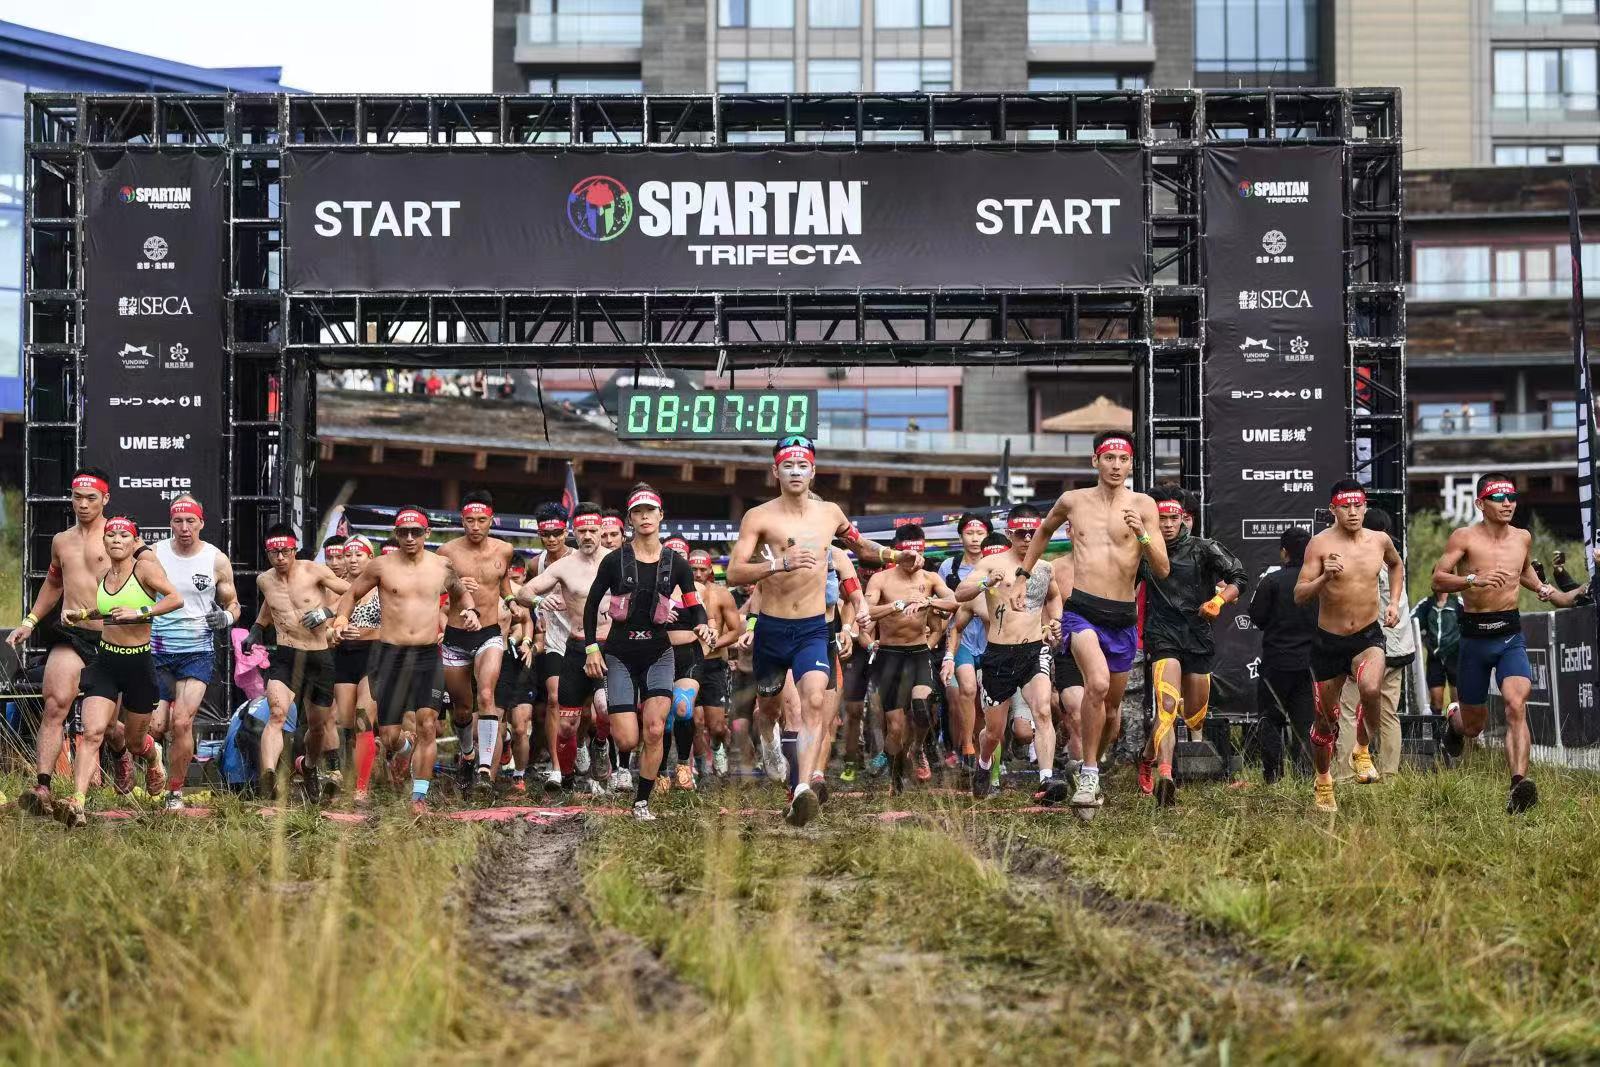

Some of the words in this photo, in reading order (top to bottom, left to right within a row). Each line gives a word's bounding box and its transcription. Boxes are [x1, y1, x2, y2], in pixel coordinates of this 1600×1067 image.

[136, 187, 191, 202] SPARTAN
[1254, 182, 1309, 196] SPARTAN
[638, 180, 862, 236] SPARTAN
[975, 198, 1121, 235] START
[314, 200, 460, 237] START
[688, 244, 862, 266] TRIFECTA
[141, 296, 194, 315] SECA
[1261, 290, 1313, 308] SECA
[110, 397, 142, 406] BYD
[1231, 390, 1264, 398] BYD
[628, 395, 809, 433] 08:07:00
[119, 476, 191, 488] Casarte
[1242, 469, 1314, 480] Casarte
[105, 643, 143, 655] SAUCONY
[1560, 642, 1592, 673] Casarte
